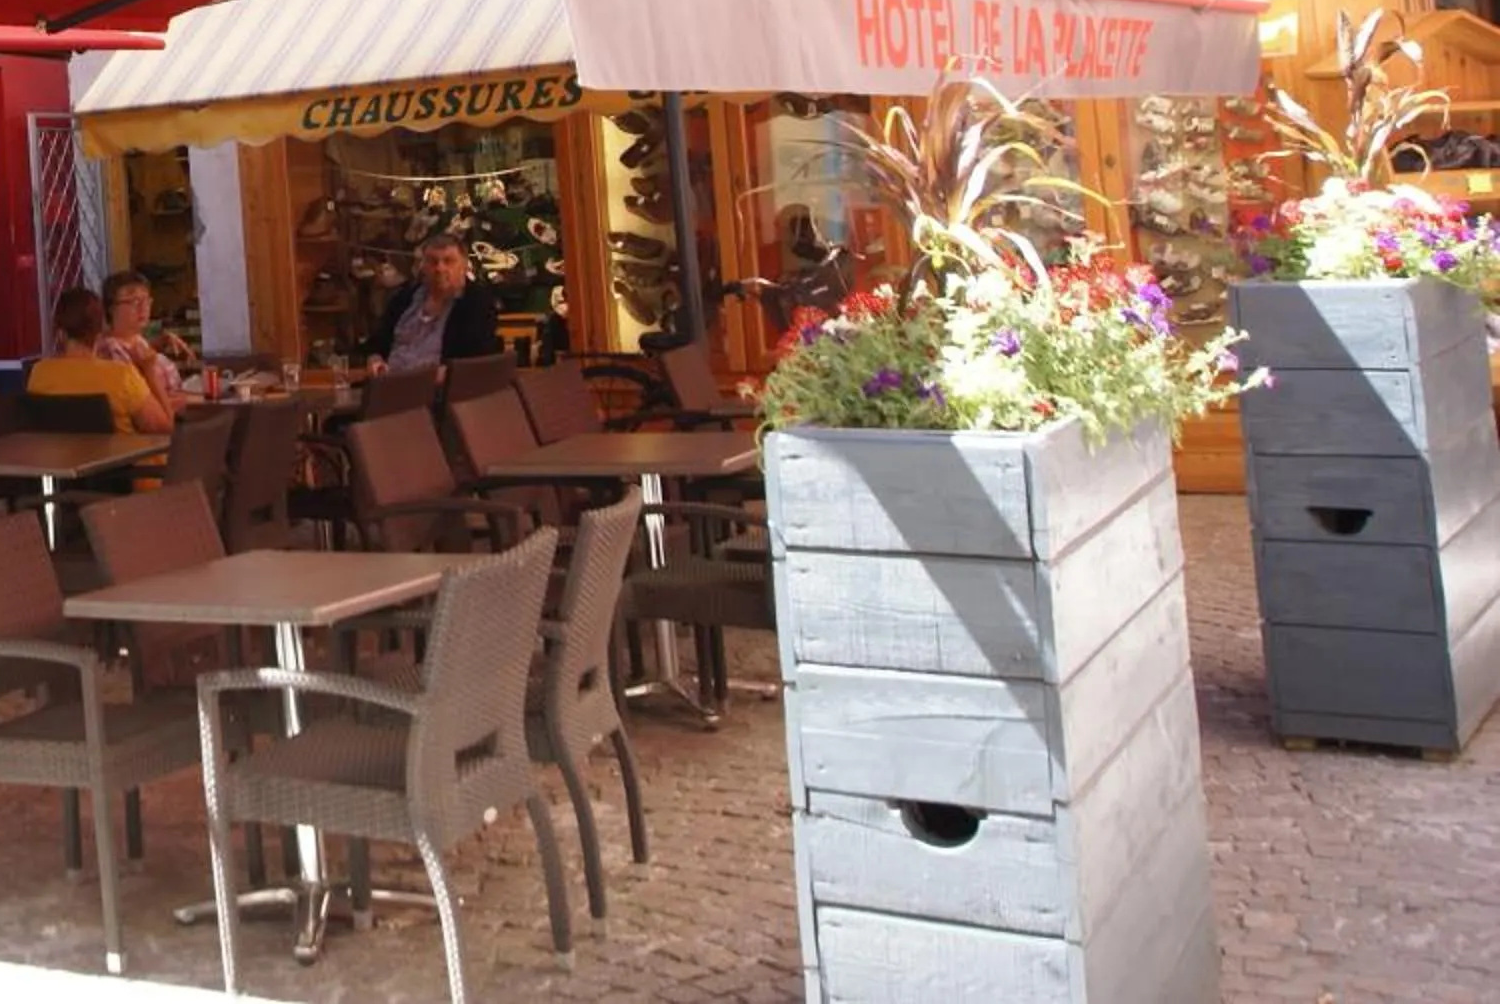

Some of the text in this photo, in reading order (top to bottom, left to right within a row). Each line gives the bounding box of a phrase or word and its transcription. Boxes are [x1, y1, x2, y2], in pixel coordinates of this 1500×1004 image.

[974, 0, 1003, 71] DE
[1013, 6, 1047, 77] LA
[302, 73, 583, 130] CHAUSSURES
